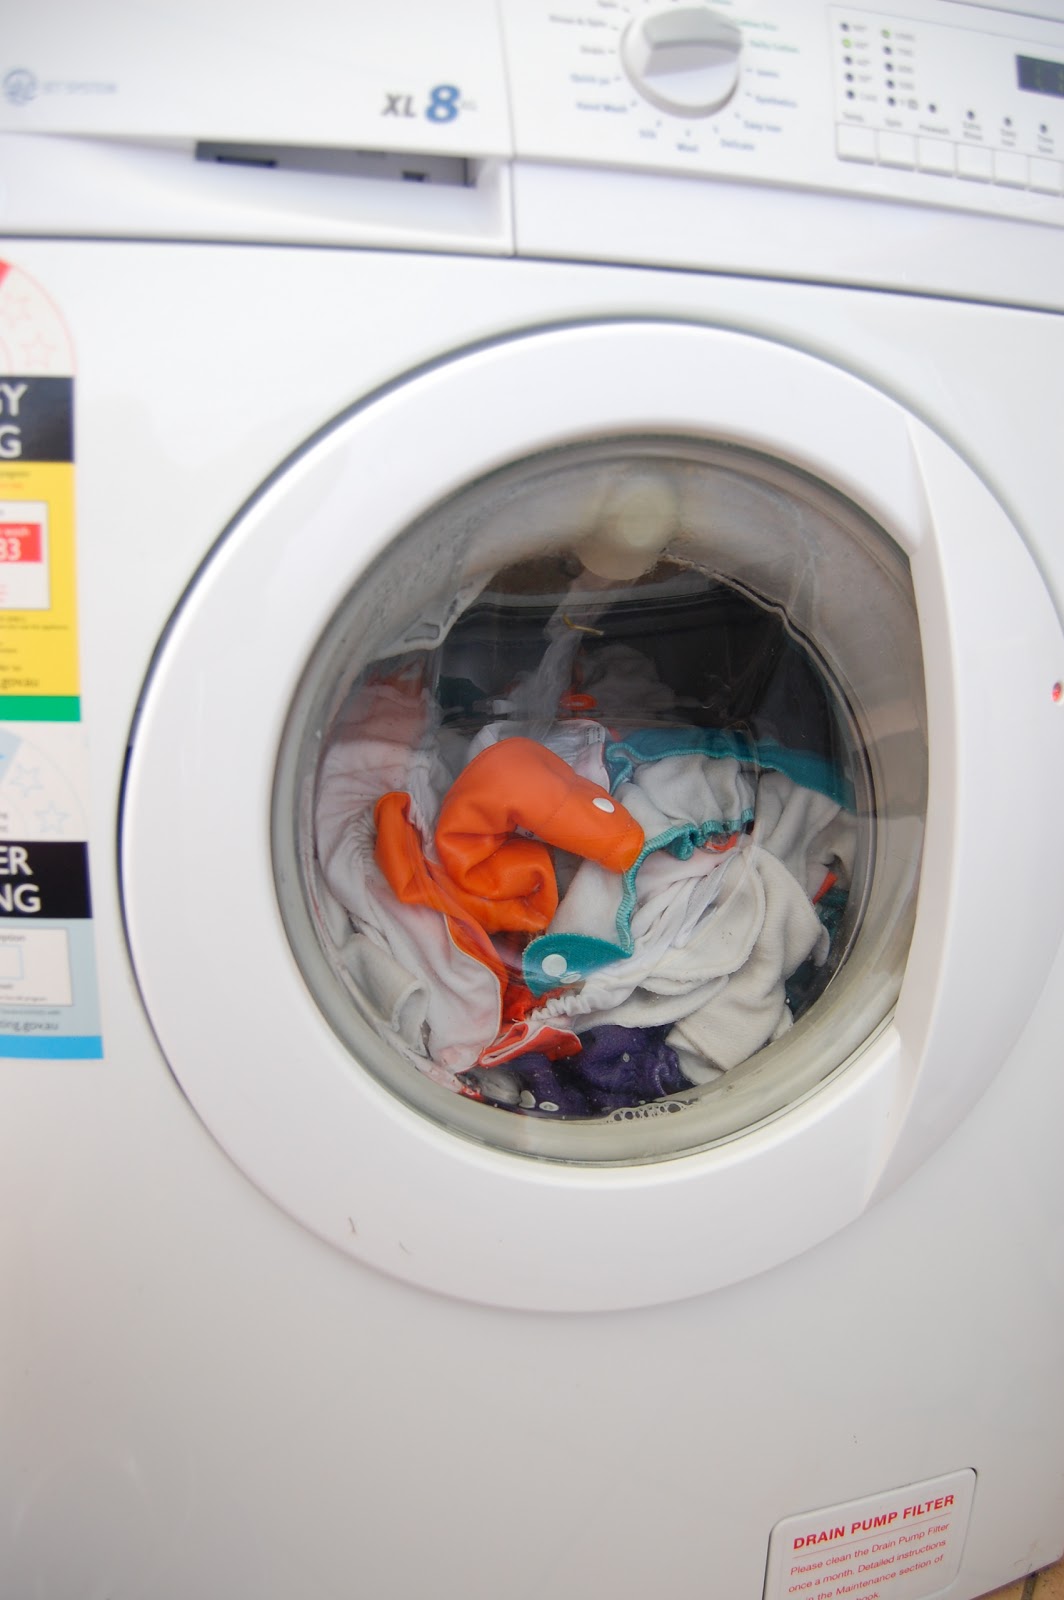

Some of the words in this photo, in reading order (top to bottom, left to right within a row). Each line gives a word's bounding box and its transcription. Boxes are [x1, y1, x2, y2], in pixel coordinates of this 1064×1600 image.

[381, 92, 417, 118] XL
[425, 84, 460, 123] 8
[0, 383, 28, 417] Y
[0, 425, 22, 458] G
[0, 846, 34, 876] ER
[0, 883, 42, 914] NG
[793, 1525, 845, 1550] DRAIN
[851, 1511, 898, 1535] PUMP
[902, 1494, 955, 1520] FILTER
[788, 1580, 813, 1593] once
[814, 1579, 821, 1587] a
[822, 1567, 855, 1583] month.
[857, 1555, 895, 1574] Detailed
[896, 1539, 947, 1561] instructions
[790, 1560, 823, 1576] Please
[825, 1552, 852, 1567] clean
[854, 1547, 869, 1558] the
[871, 1540, 896, 1553] Drain
[898, 1530, 926, 1545] Pump
[927, 1523, 950, 1536] Filter
[817, 1590, 834, 1600] the
[835, 1570, 897, 1596] Maintenance
[898, 1558, 932, 1576] section
[933, 1553, 945, 1564] of
